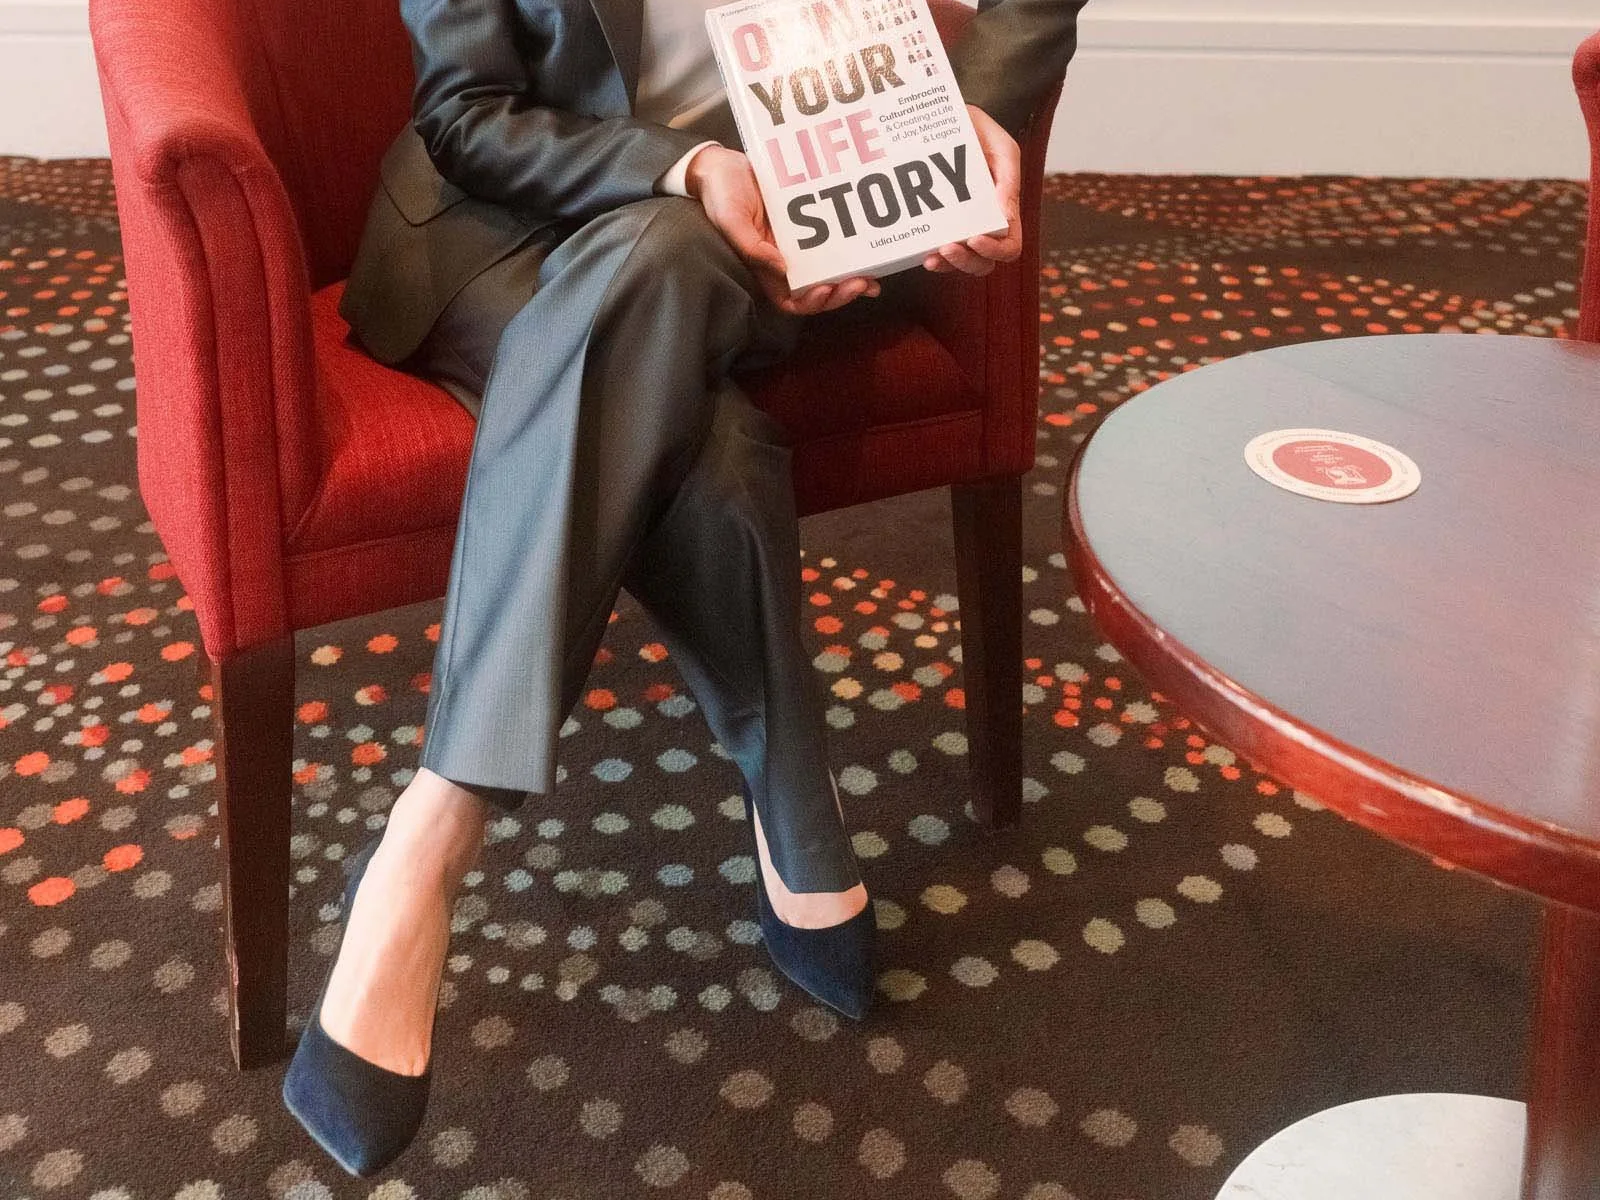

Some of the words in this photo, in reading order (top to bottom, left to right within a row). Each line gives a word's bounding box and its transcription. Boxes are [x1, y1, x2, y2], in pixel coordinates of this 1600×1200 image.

[748, 42, 906, 127] YOUR
[898, 85, 946, 105] Embracing
[879, 105, 915, 123] Cultural
[916, 95, 949, 111] Identity
[893, 113, 931, 130] Creating
[938, 105, 954, 116] Life
[892, 133, 901, 142] of
[931, 126, 961, 140] Legacy
[766, 108, 887, 189] LIFE
[786, 144, 972, 251] STORY
[870, 237, 893, 249] Lidia
[910, 224, 931, 236] PhD
